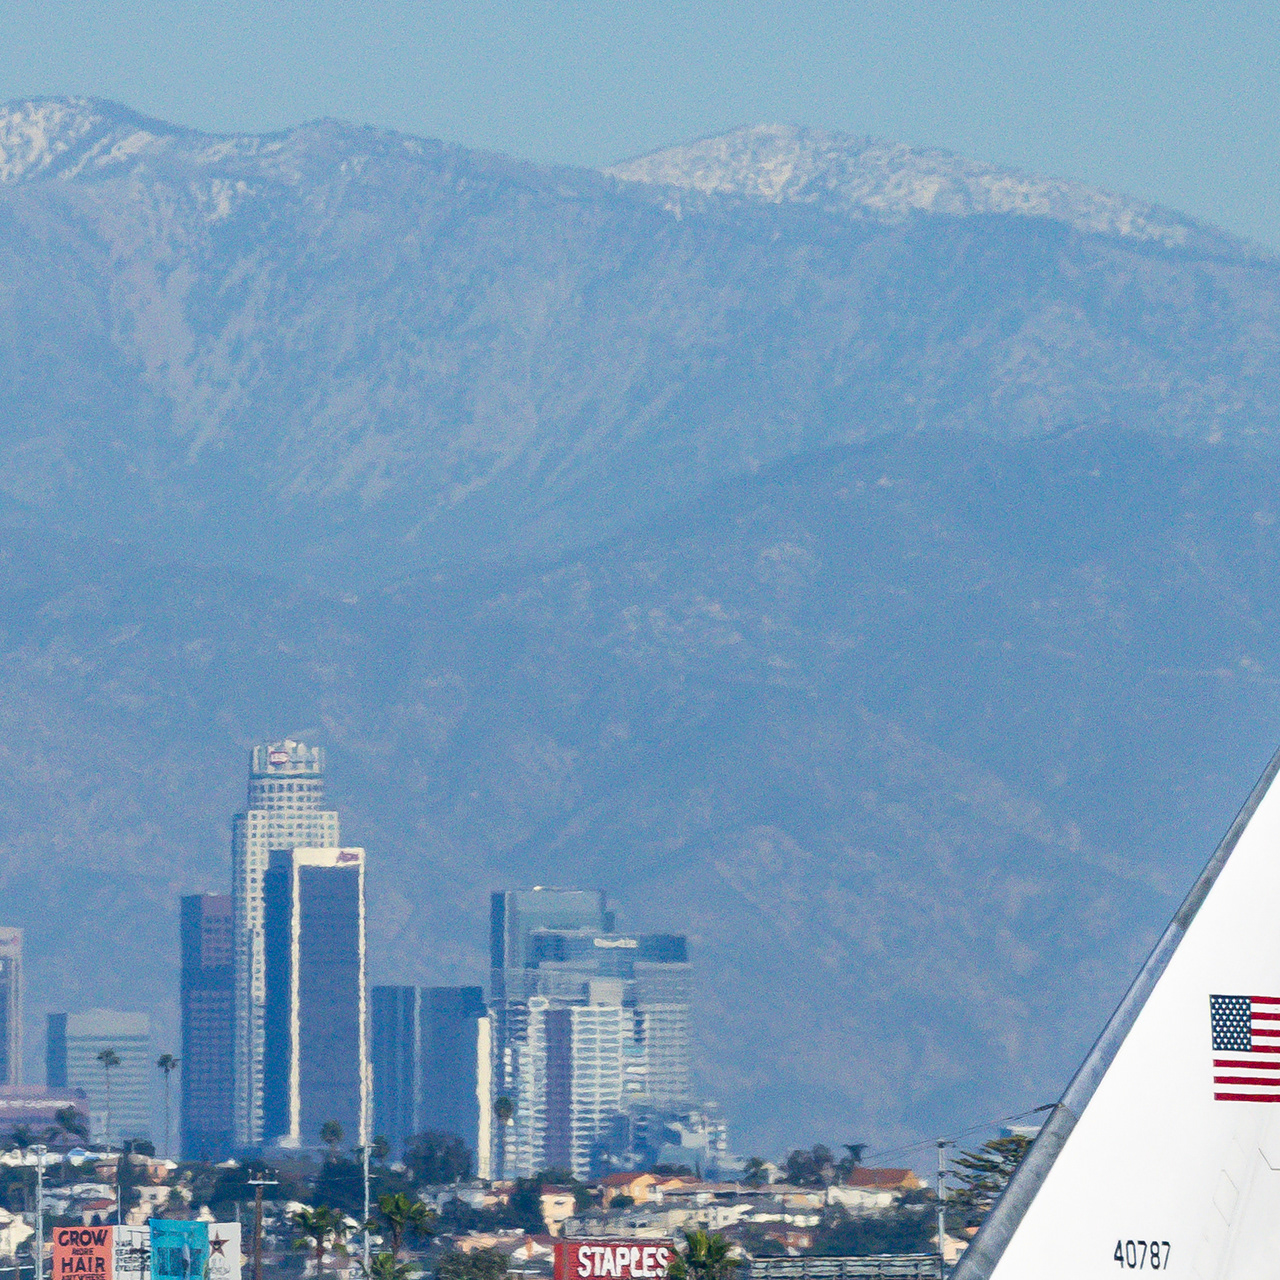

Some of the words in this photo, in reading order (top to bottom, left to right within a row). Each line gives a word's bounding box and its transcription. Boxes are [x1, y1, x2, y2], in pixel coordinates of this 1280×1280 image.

[58, 1229, 108, 1247] GROW
[61, 1256, 106, 1273] HAIR
[577, 1245, 670, 1278] STAPLES
[1113, 1239, 1171, 1270] 40787
